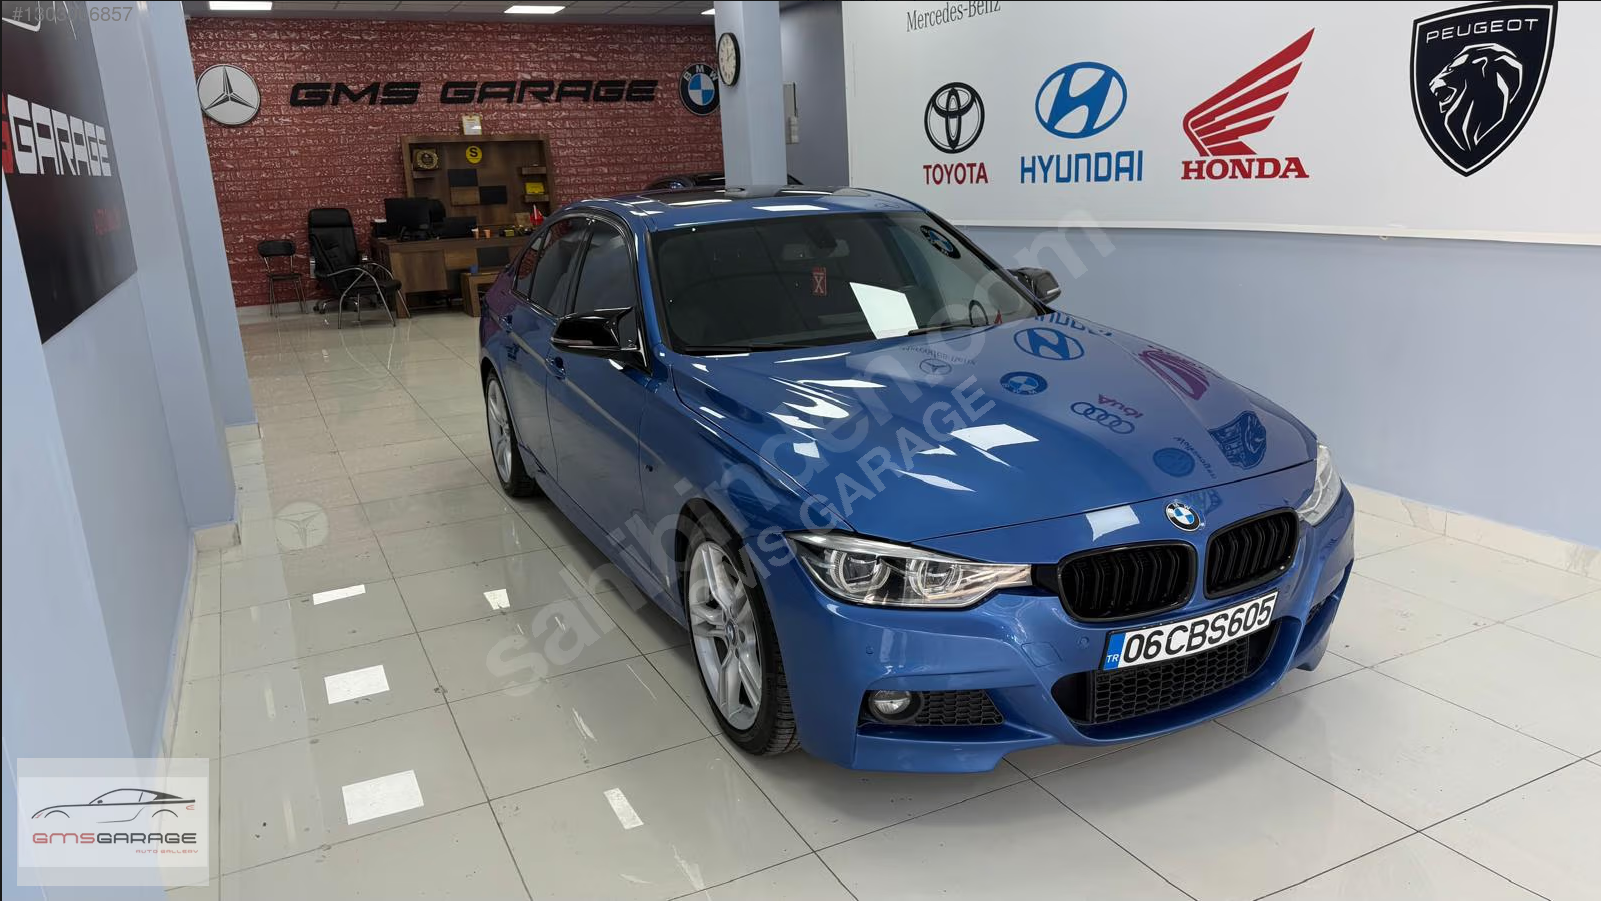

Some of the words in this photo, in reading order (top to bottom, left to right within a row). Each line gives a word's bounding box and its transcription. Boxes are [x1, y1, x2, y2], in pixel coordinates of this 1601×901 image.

[906, 1, 1001, 32] Mercedes-Benz
[1426, 18, 1539, 43] PEUGEOT
[290, 82, 421, 107] GMS
[440, 80, 658, 104] GARAGE
[923, 162, 989, 185] TOYOTA
[1020, 150, 1144, 184] HYUNDAI
[1181, 157, 1310, 180] HONDA
[1123, 595, 1276, 664] 06CBS605
[1107, 653, 1119, 664] TR
